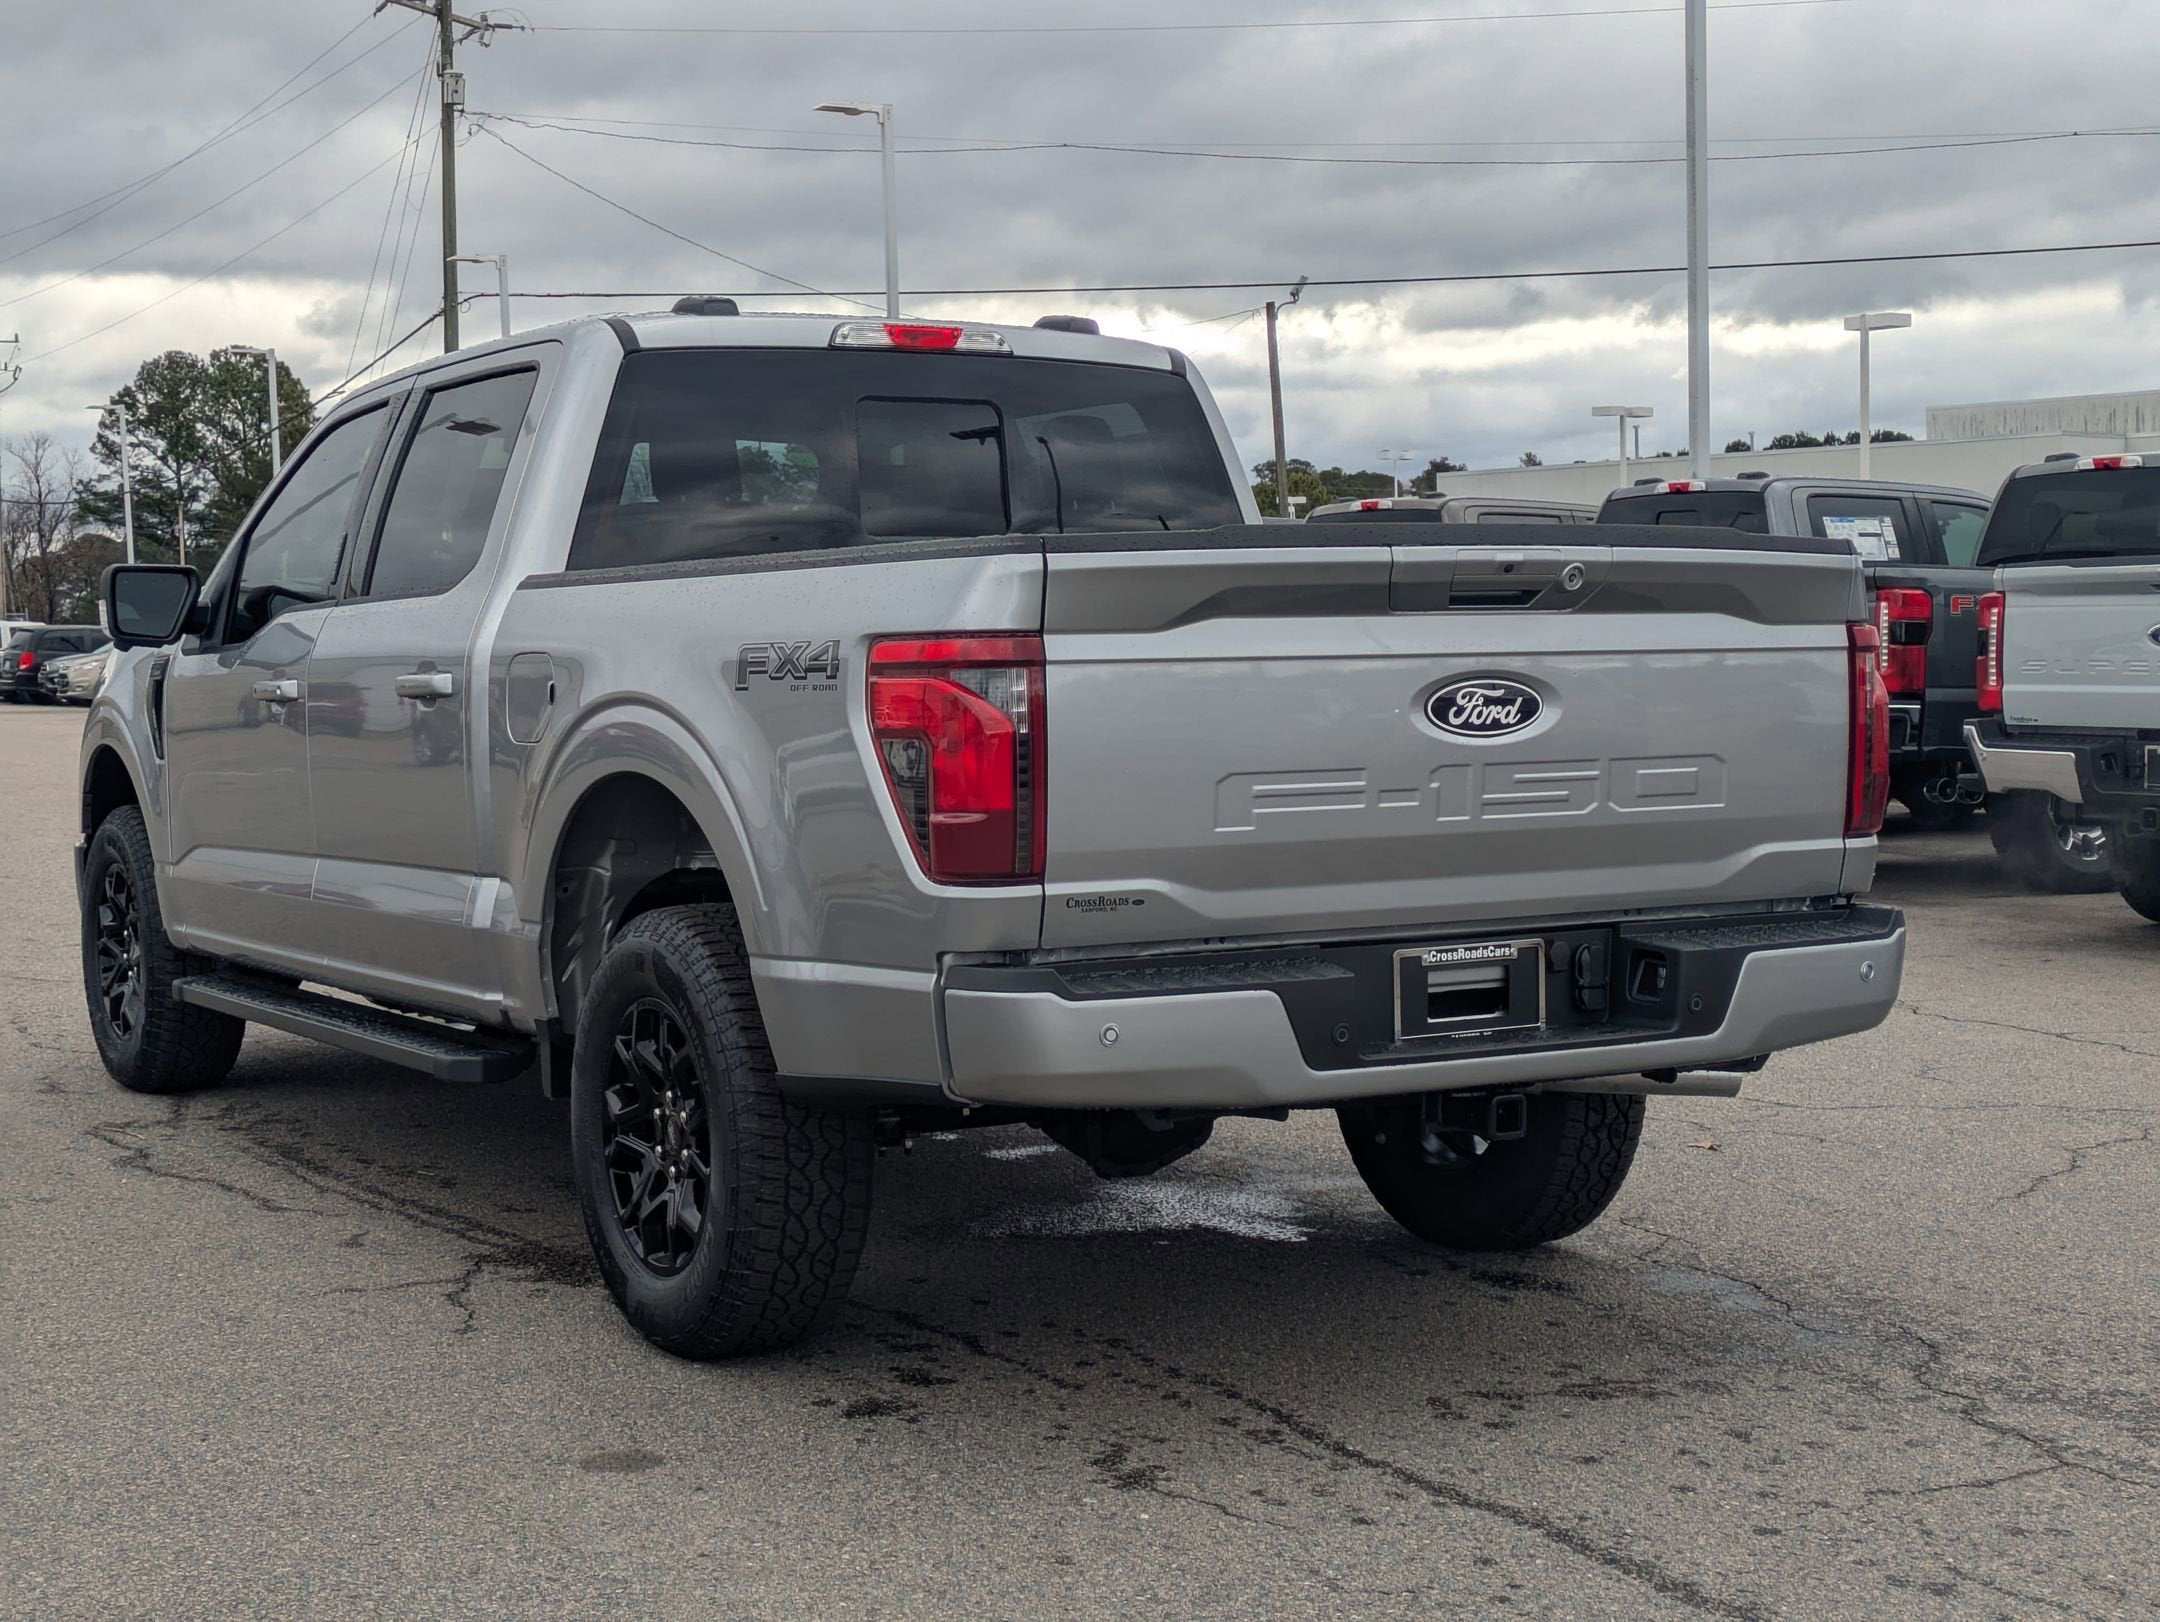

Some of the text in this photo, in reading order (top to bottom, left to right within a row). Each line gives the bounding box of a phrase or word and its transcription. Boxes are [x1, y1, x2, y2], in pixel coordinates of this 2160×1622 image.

[735, 640, 840, 691] FX4
[2021, 659, 2160, 675] SUPE
[790, 683, 838, 692] OFF ROAD
[1448, 686, 1521, 726] Ford
[1215, 753, 1727, 832] F-150
[1429, 946, 1510, 962] CrossRoadsCars
